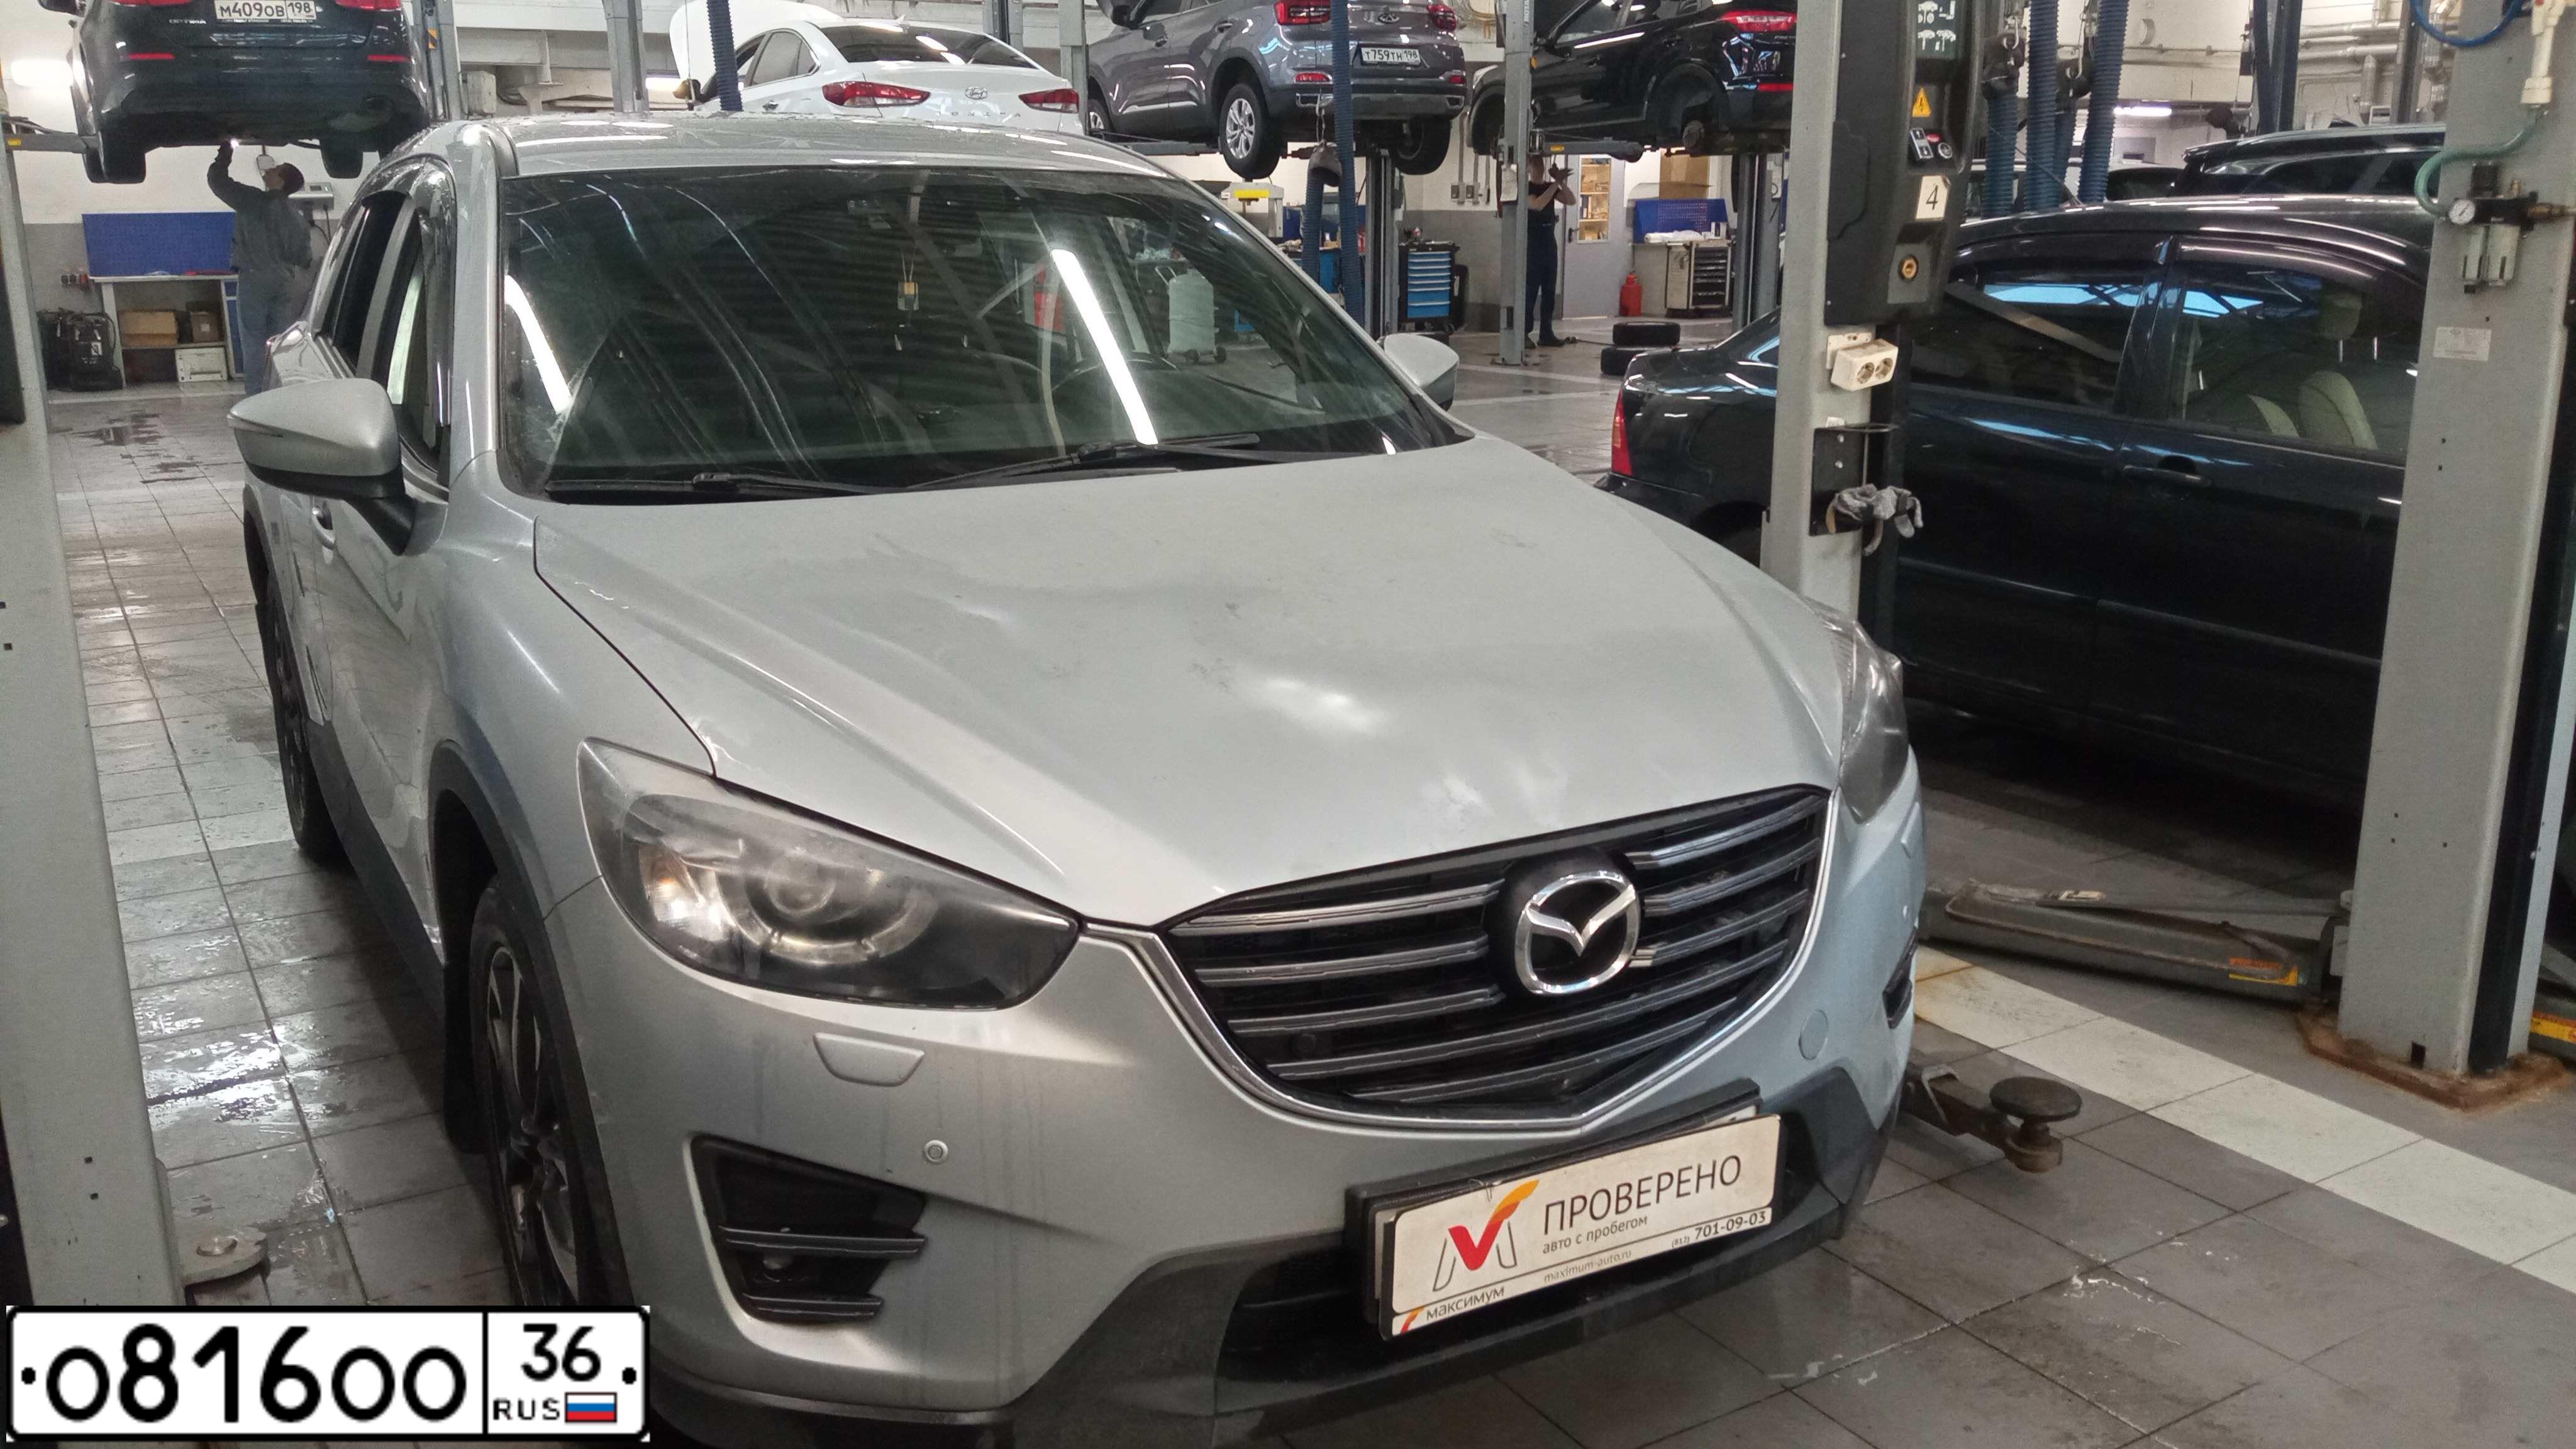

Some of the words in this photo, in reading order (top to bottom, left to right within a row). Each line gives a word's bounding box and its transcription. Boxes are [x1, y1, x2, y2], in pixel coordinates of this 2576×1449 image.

[1926, 185, 1938, 211] 4
[1543, 1155, 1741, 1236] ПРОВЕРЕНО
[1542, 1237, 1572, 1254] авто
[1575, 1233, 1582, 1245] с
[1586, 1216, 1648, 1243] пробегом
[1694, 1210, 1766, 1240] 701-09-03
[1544, 1250, 1632, 1283] maximum-auto.ru
[1426, 1285, 1505, 1321] максимум
